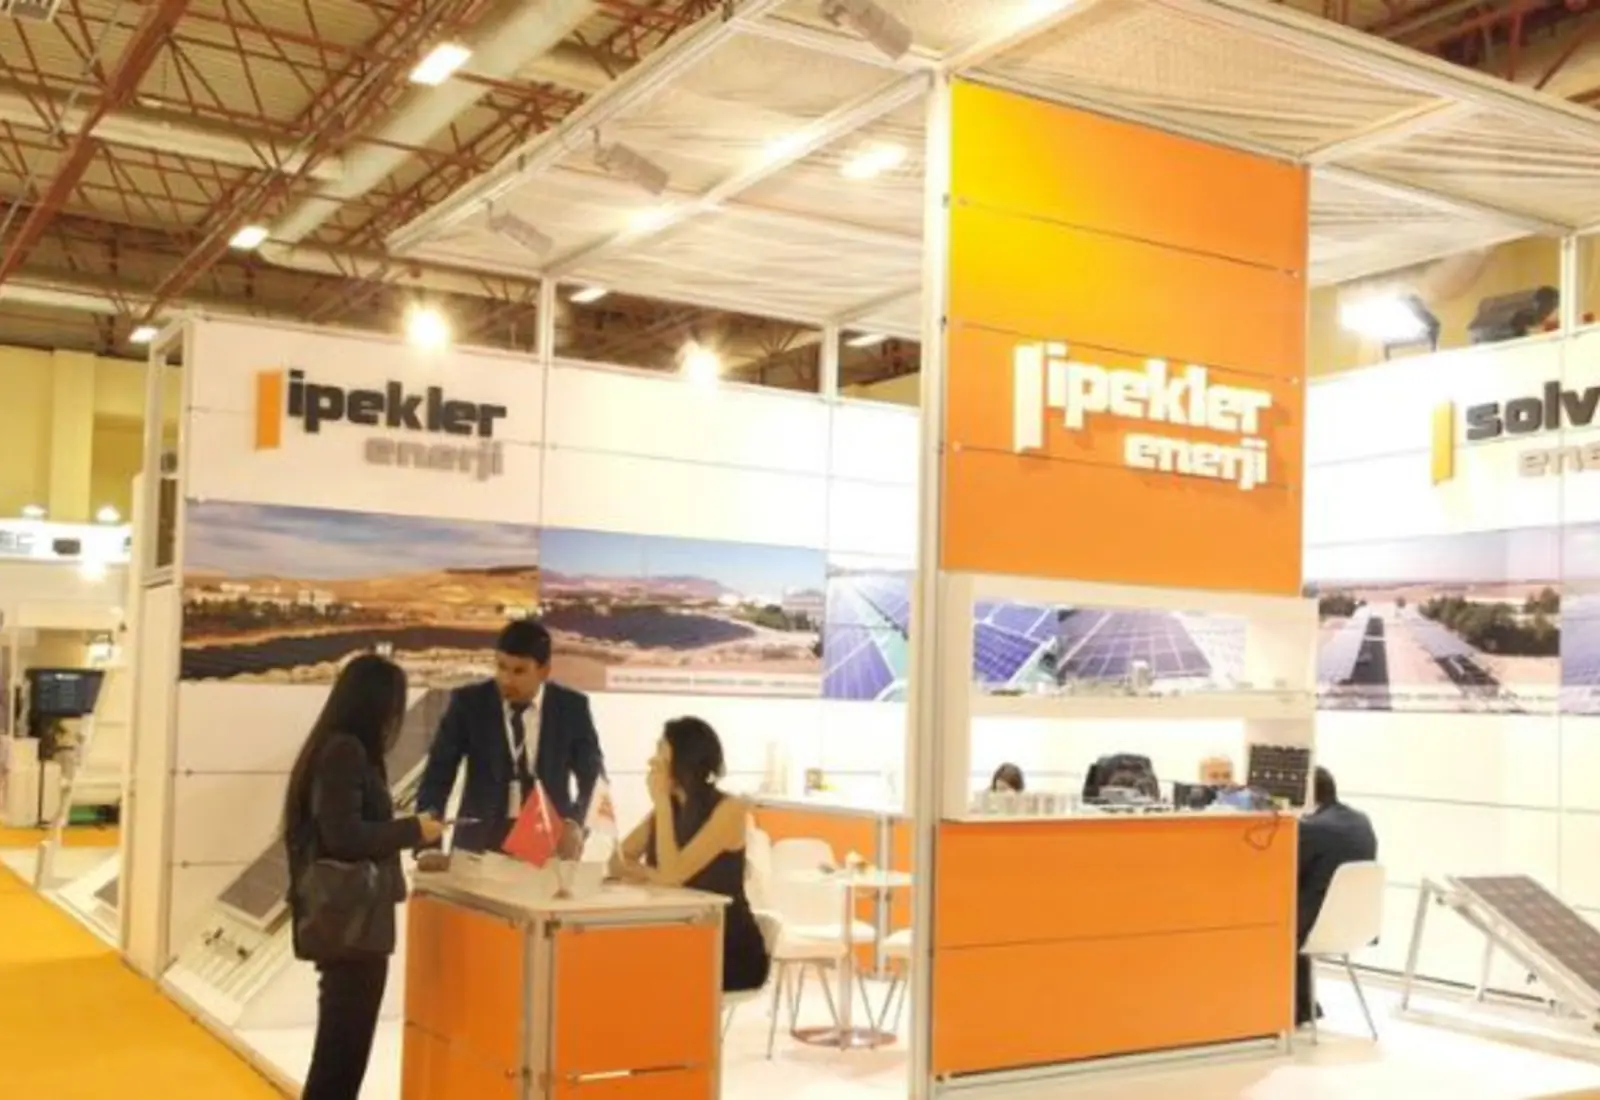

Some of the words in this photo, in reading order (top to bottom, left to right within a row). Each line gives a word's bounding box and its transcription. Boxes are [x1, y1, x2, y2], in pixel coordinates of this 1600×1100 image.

[288, 369, 507, 437] ipekler
[1046, 341, 1270, 433] ipekler
[365, 437, 503, 481] enerji
[1125, 434, 1267, 489] enerji
